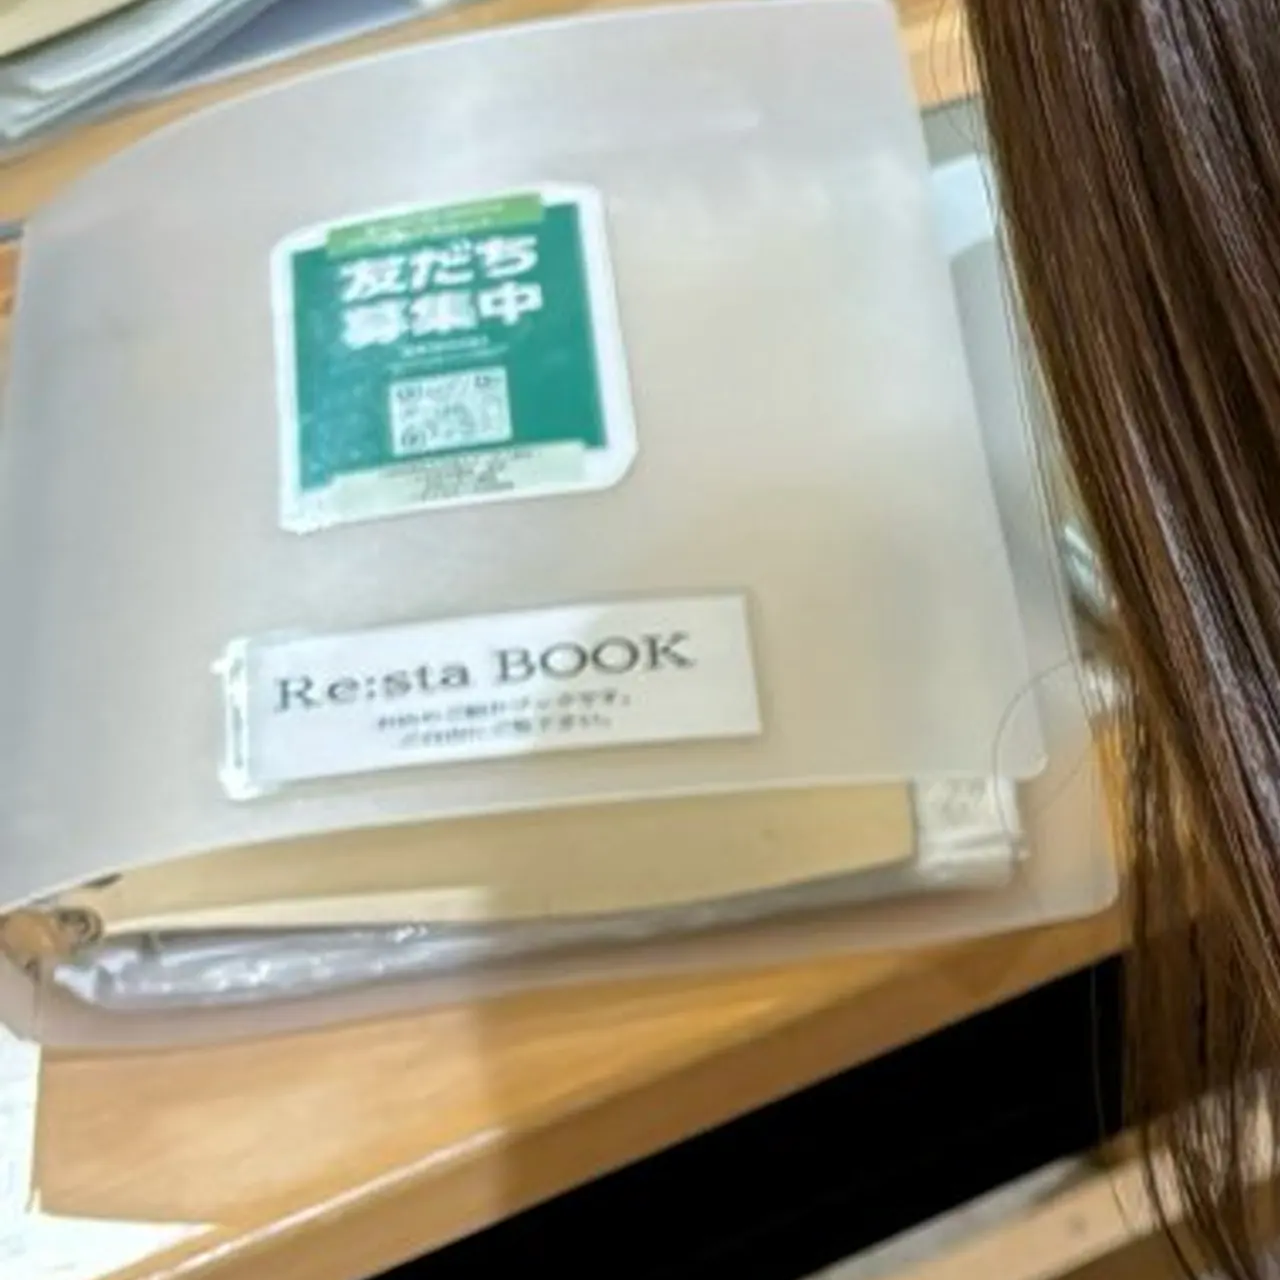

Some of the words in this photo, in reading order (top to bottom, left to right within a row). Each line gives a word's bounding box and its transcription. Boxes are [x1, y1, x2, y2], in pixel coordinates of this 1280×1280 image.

[339, 234, 539, 302] 友だち
[274, 660, 471, 713] Re:sta
[497, 631, 696, 683] BOOK
